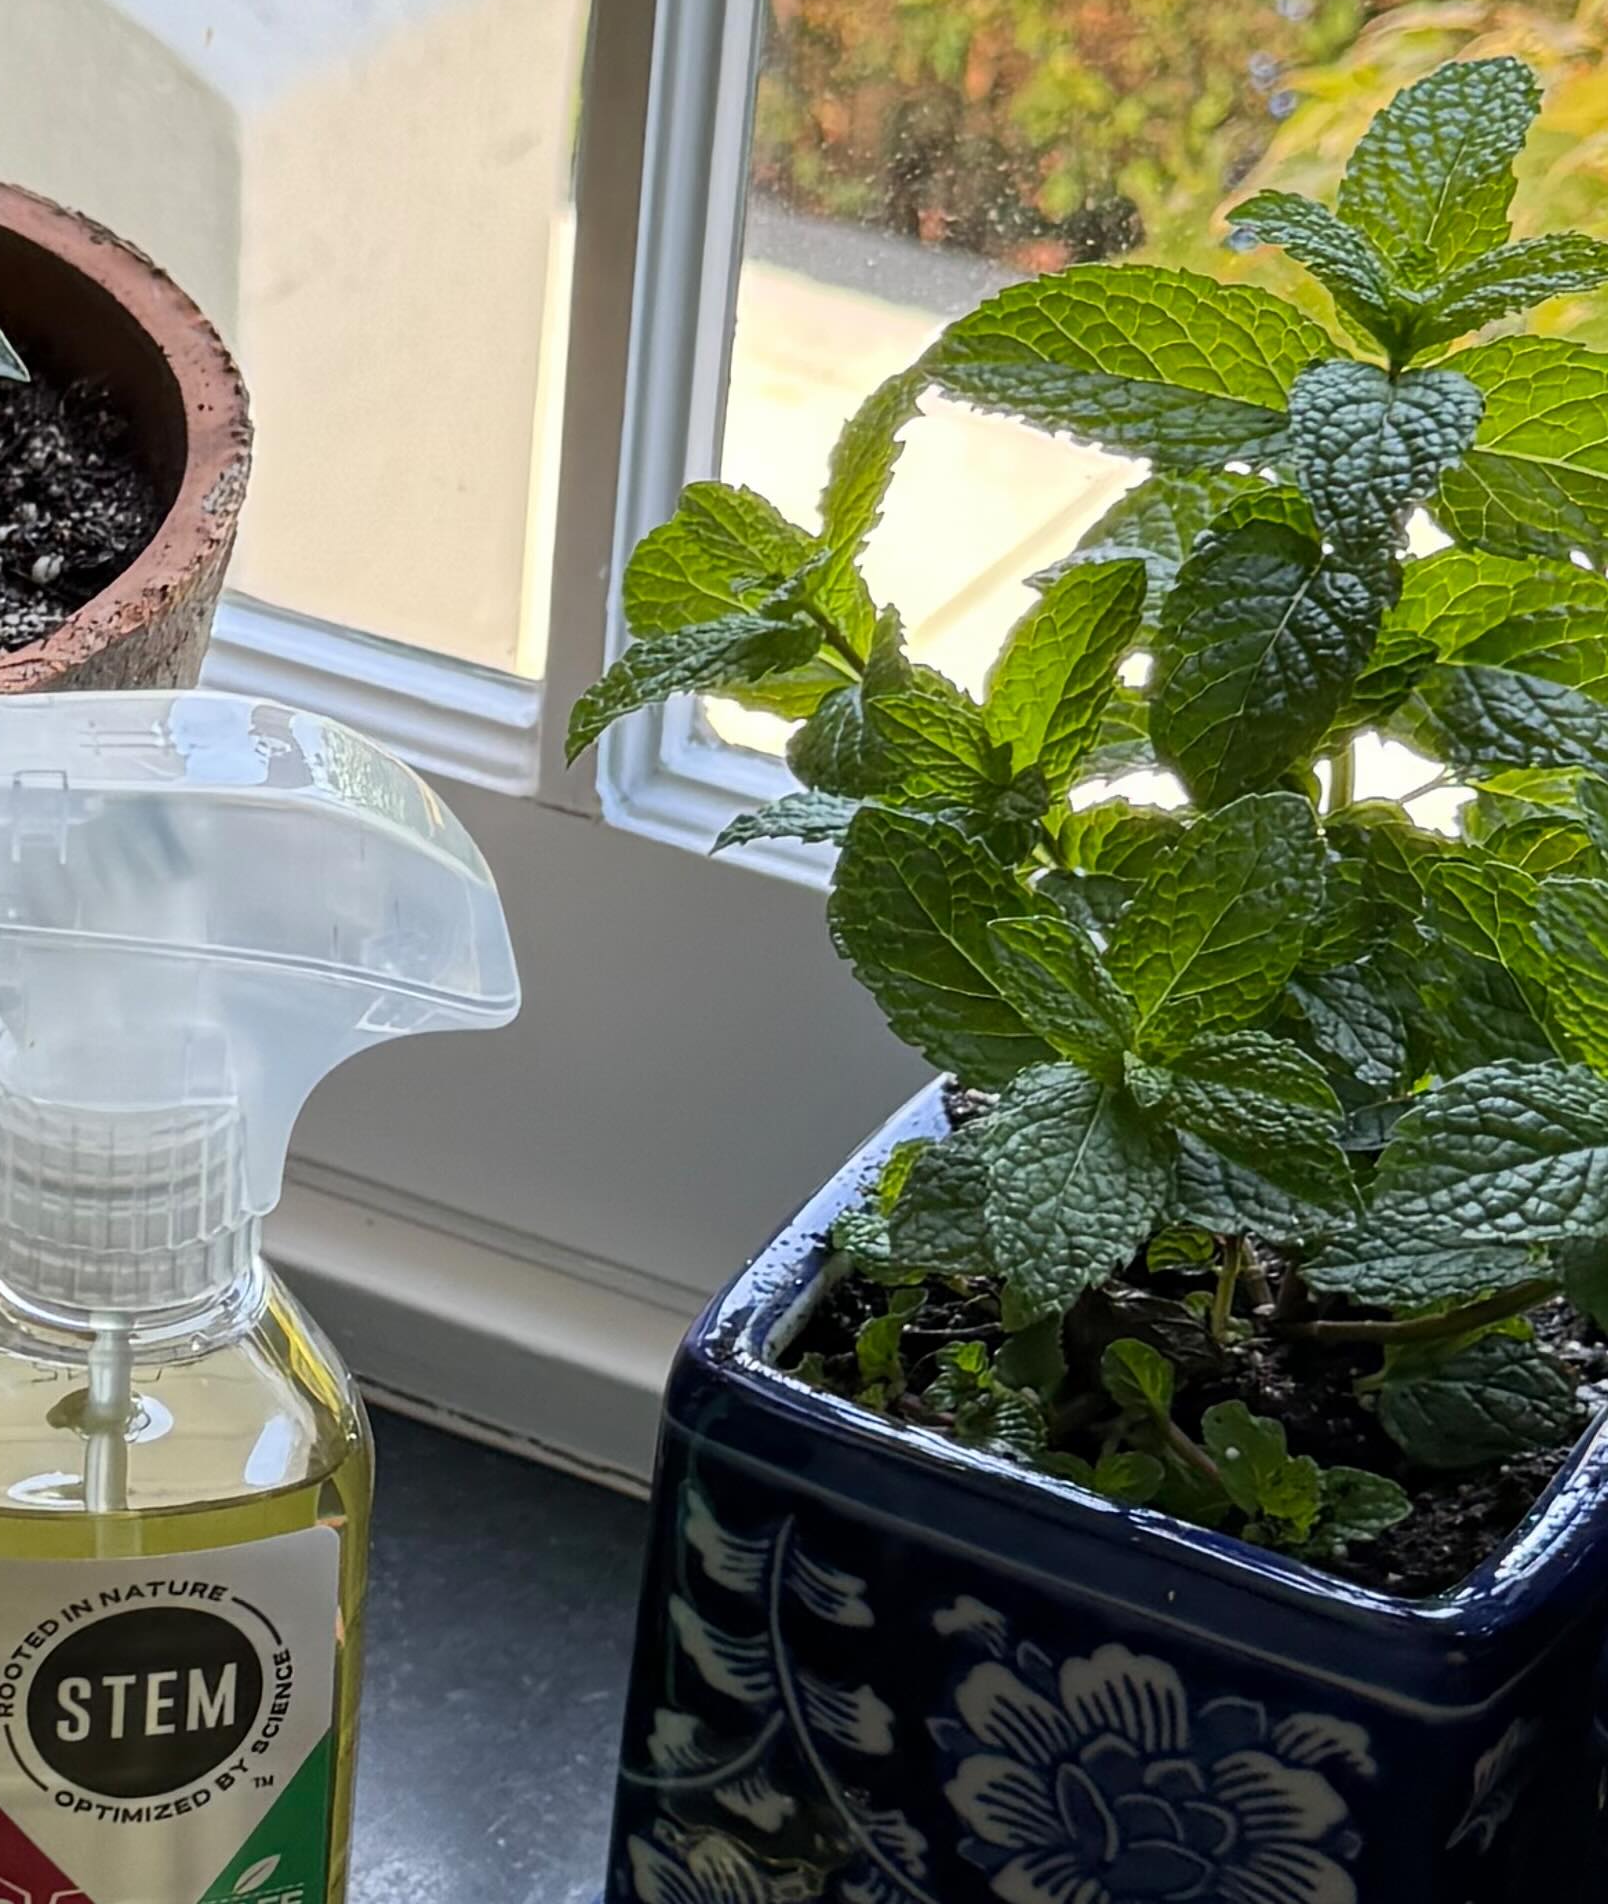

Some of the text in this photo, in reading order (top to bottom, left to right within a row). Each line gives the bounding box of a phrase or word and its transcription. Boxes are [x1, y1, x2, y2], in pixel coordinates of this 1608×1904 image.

[61, 1599, 92, 1622] IN
[99, 1580, 228, 1607] NATURE
[56, 1662, 237, 1742] STEM
[55, 1648, 293, 1823] OPTIMIZED BY SCIENCE
[253, 1775, 274, 1788] TM
